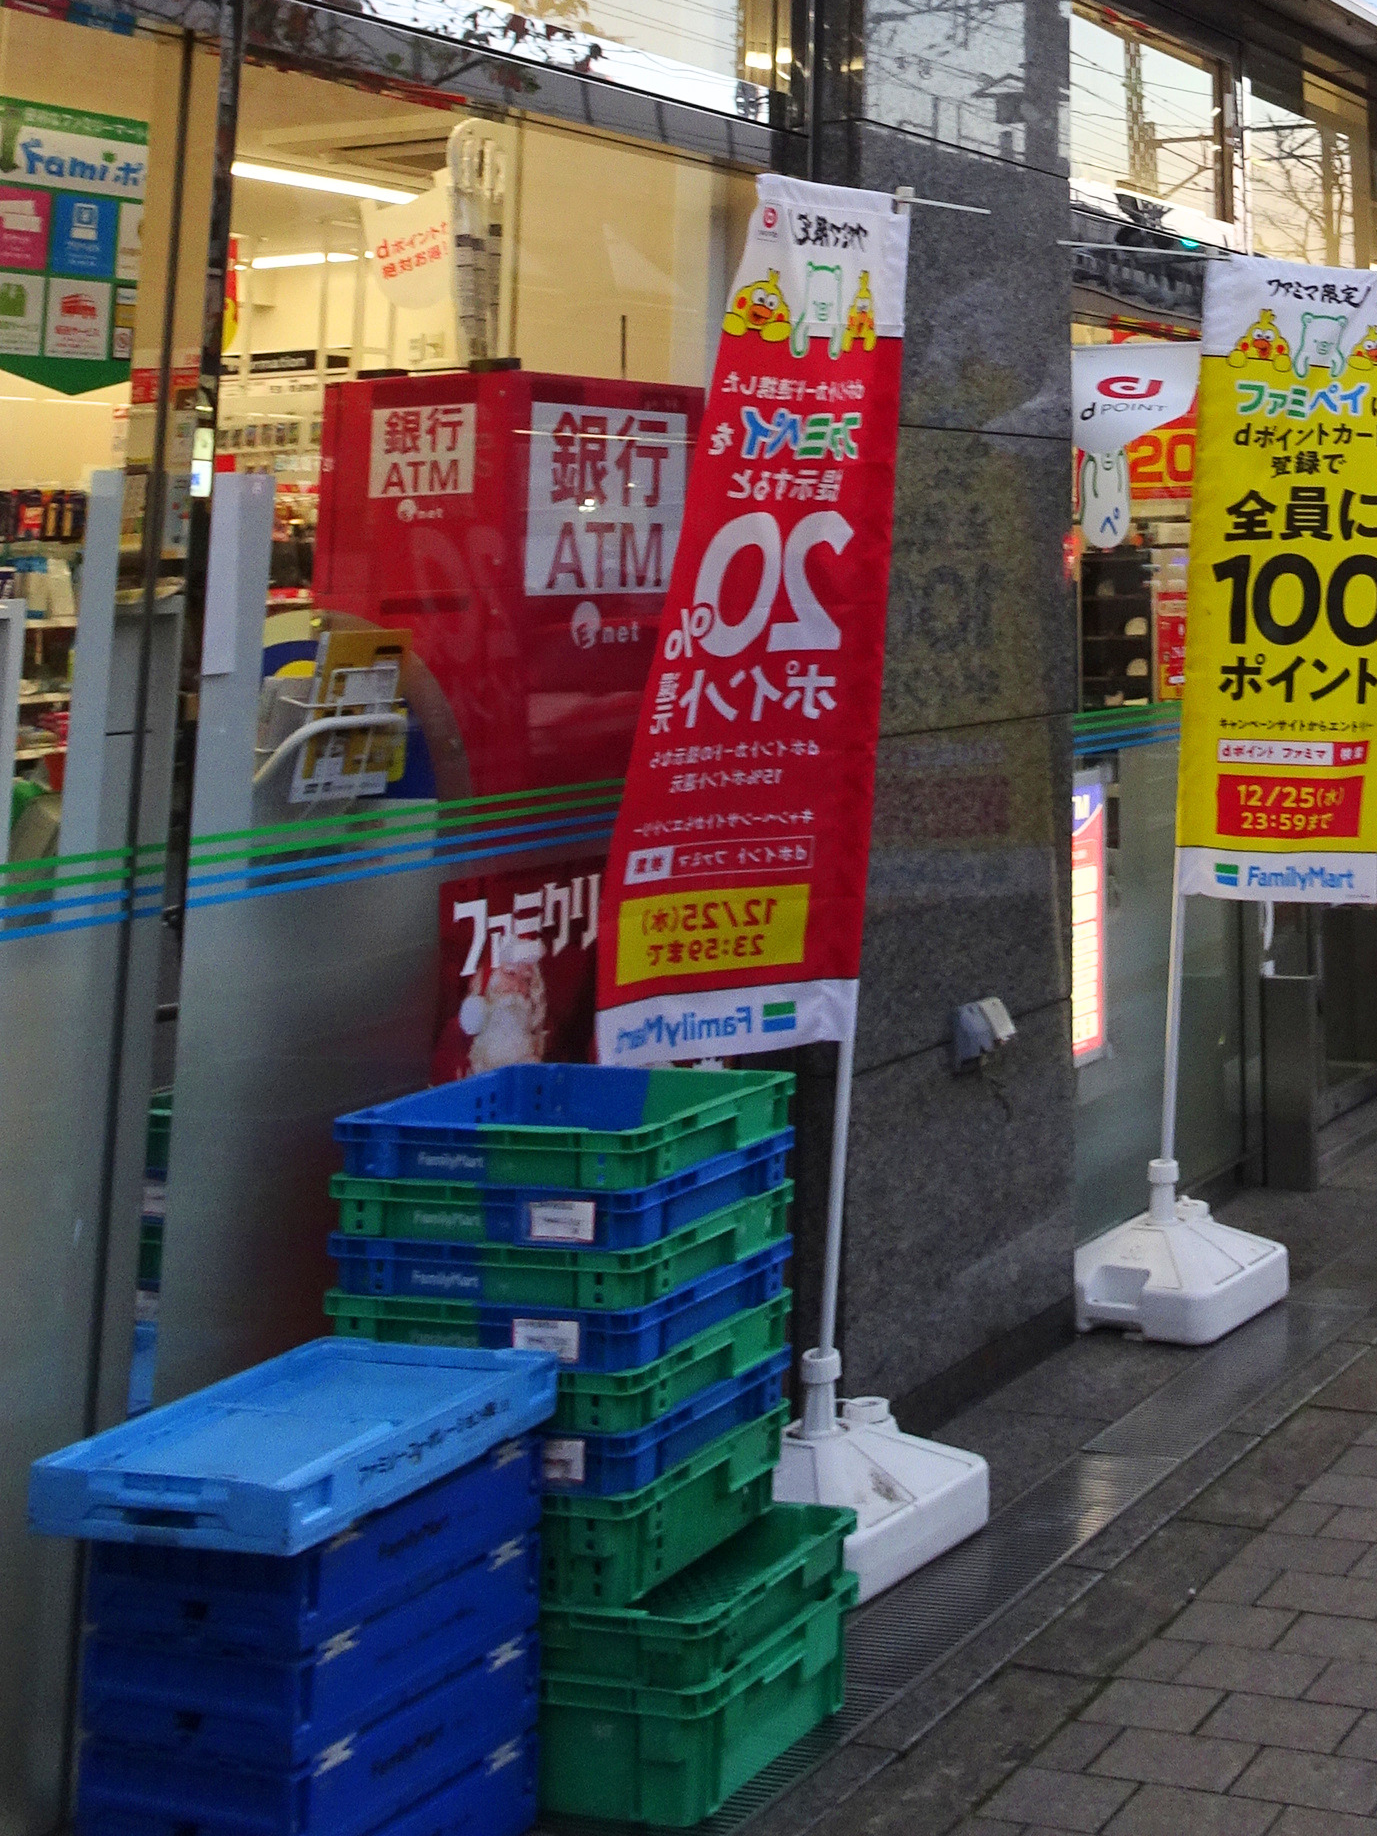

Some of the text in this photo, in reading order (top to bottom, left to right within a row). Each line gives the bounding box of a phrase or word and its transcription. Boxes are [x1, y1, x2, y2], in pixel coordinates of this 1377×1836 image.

[1267, 277, 1362, 310] ファミマ限定
[1080, 401, 1168, 422] d POINT
[383, 405, 465, 456] 銀行
[548, 411, 669, 508] 銀行
[1271, 449, 1348, 478] 登録で
[380, 457, 462, 497] ATM
[546, 520, 664, 591] ATM
[1221, 745, 1275, 759] dポイント
[1281, 746, 1328, 760] ファミマ
[1236, 784, 1346, 809] 12/25(水)
[1240, 812, 1335, 832] 23:59まで
[1247, 865, 1355, 892] FamilyMart
